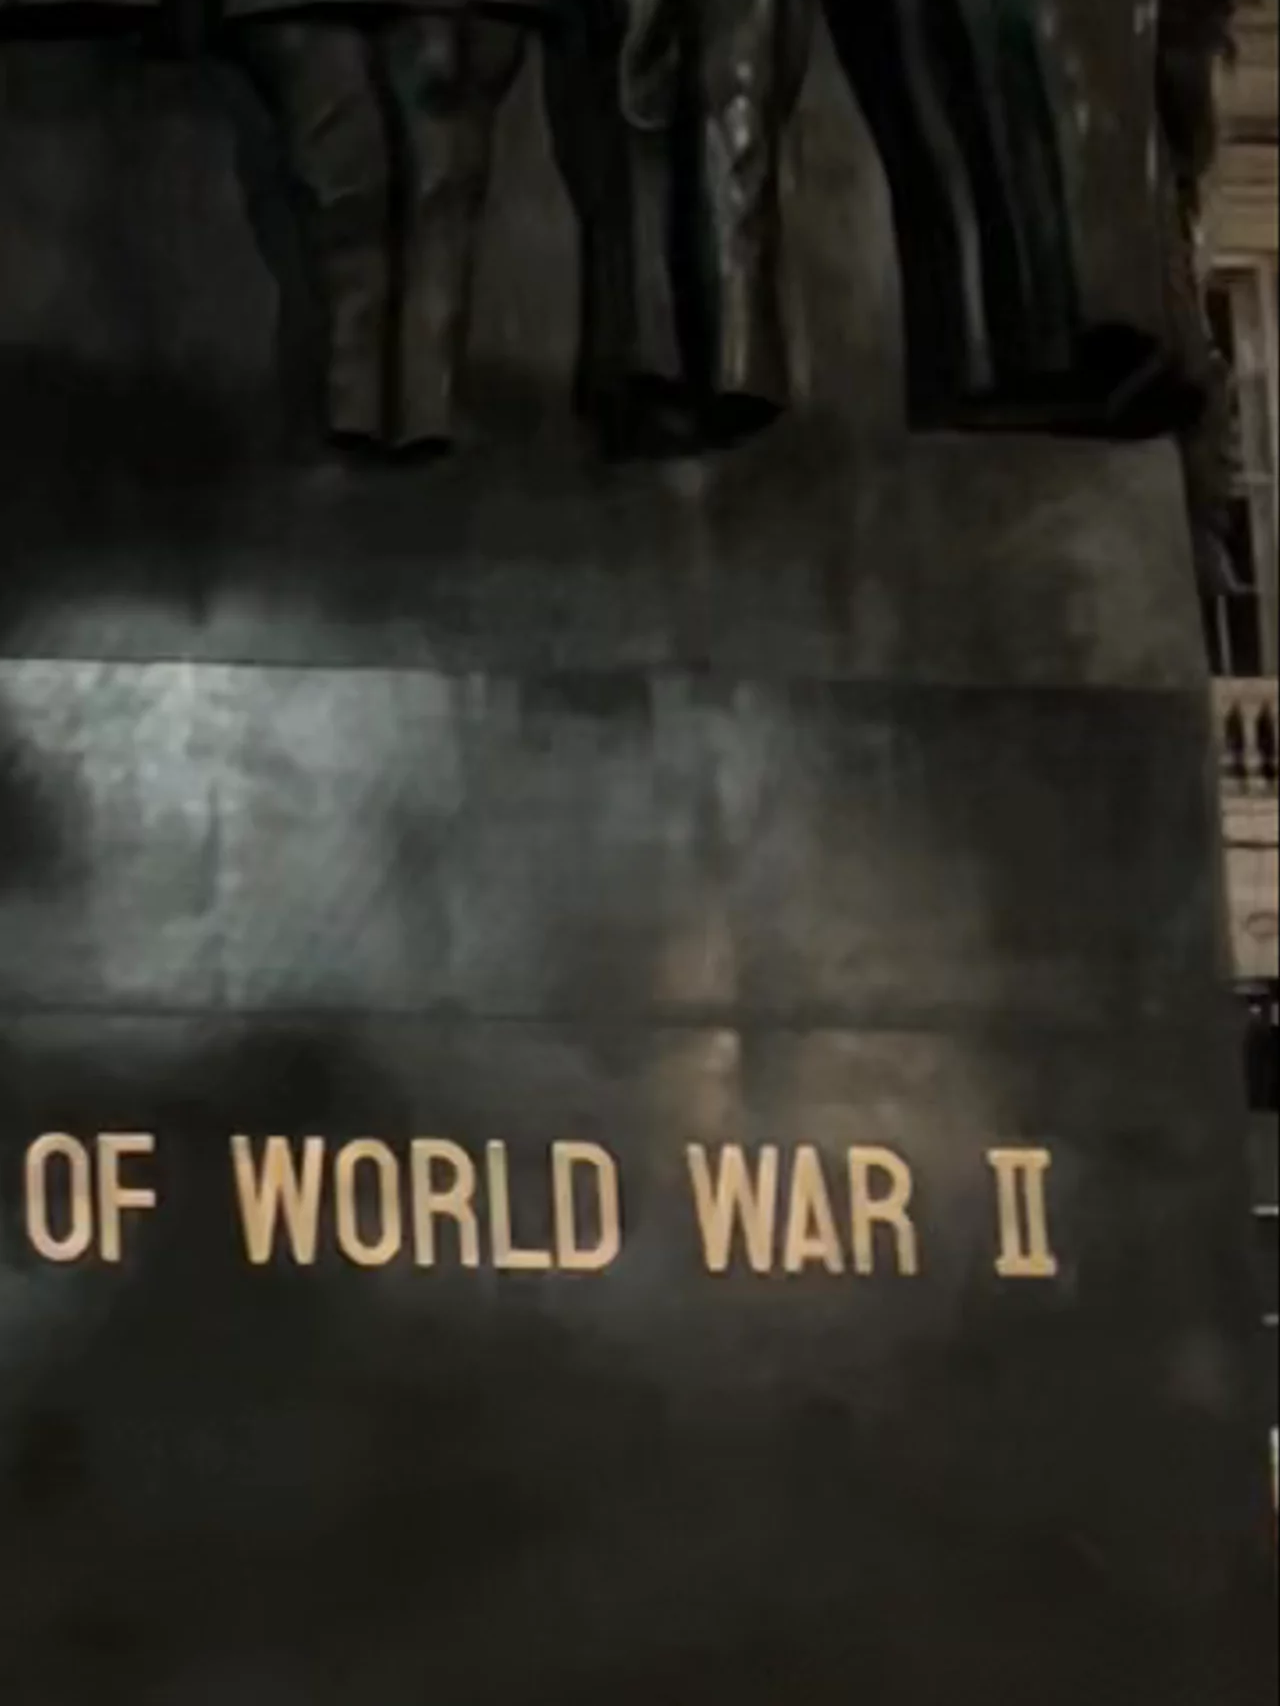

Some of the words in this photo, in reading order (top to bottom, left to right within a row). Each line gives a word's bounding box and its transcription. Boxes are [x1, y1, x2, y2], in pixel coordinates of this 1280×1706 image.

[24, 1132, 157, 1263] OF
[232, 1134, 621, 1272] WORLD
[684, 1142, 917, 1276] WAR
[986, 1147, 1058, 1278] II
